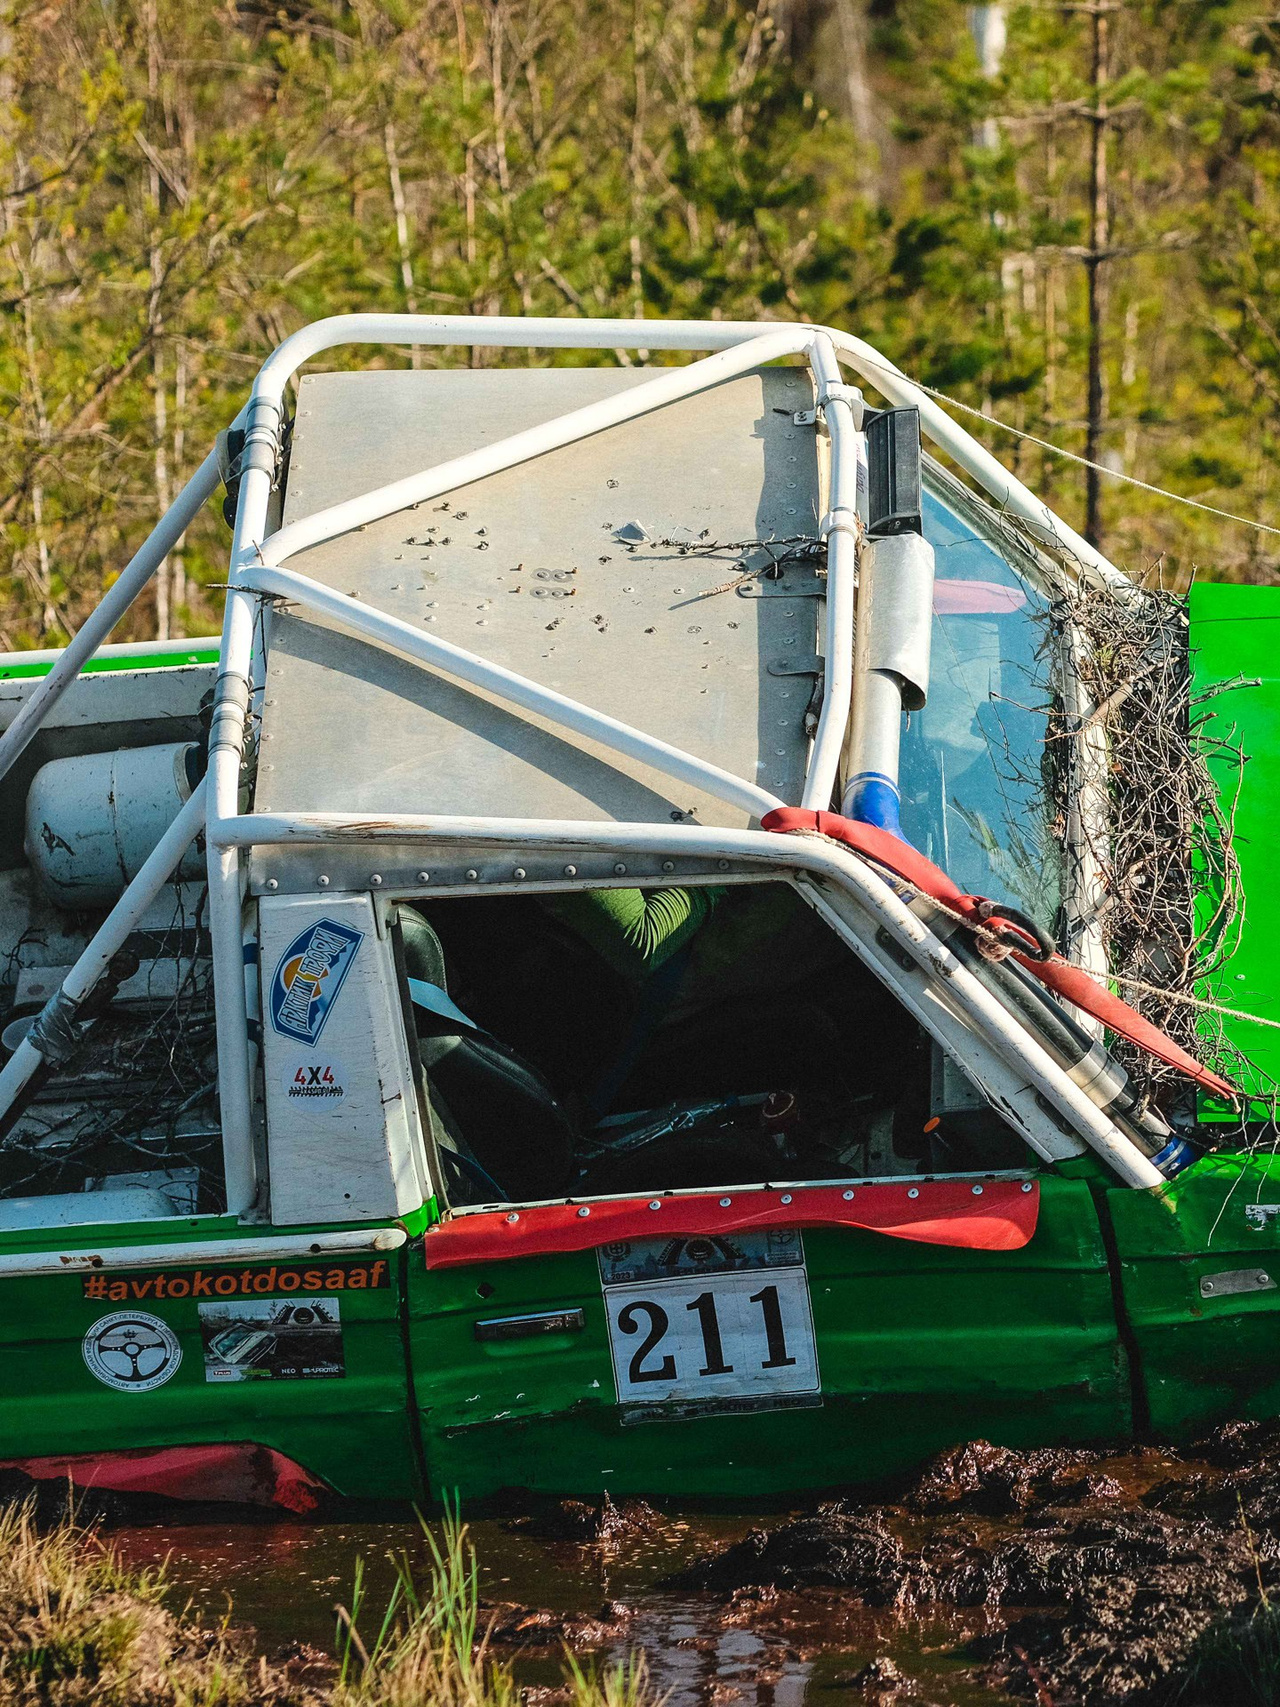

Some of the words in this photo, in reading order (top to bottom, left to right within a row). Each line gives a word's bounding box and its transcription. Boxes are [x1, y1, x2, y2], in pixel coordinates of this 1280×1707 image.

[299, 928, 350, 977] ТРОФИ
[84, 1260, 387, 1300] #avtokotdosaaf
[611, 1272, 631, 1280] 2023
[617, 1285, 796, 1384] 211
